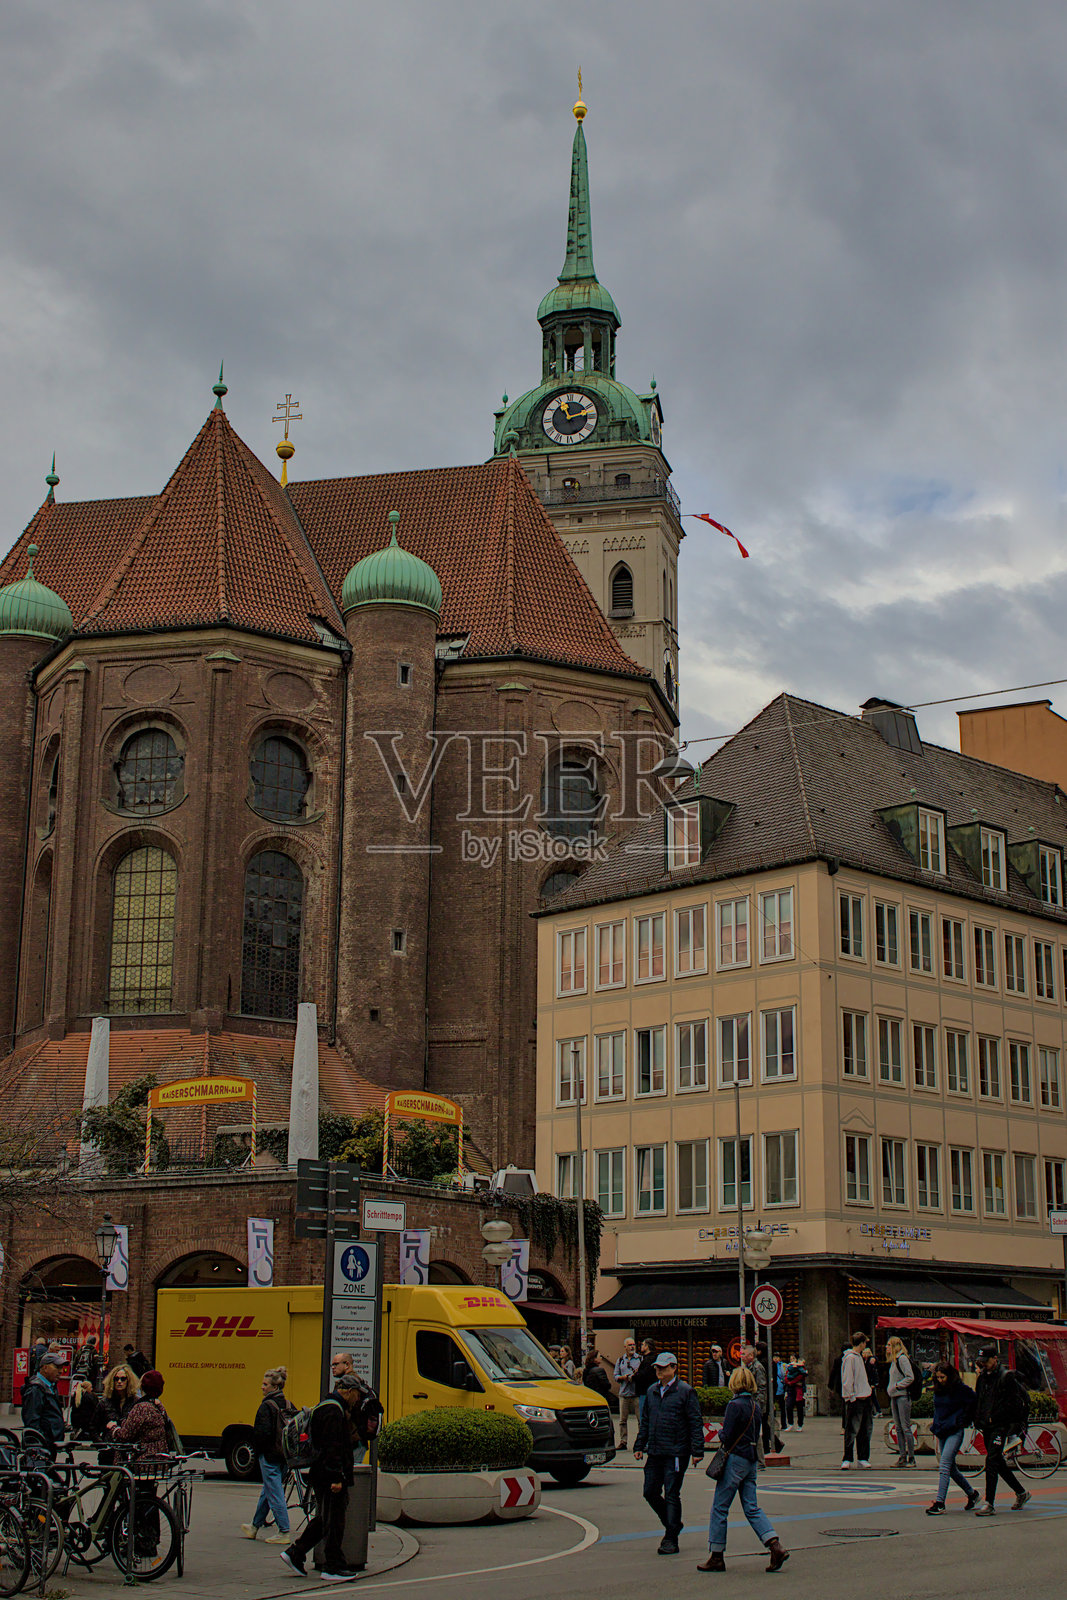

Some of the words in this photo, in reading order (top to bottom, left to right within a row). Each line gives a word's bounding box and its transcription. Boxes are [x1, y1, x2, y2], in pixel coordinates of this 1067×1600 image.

[343, 1283, 366, 1294] ZONE
[463, 1296, 508, 1308] DHL
[183, 1315, 259, 1337] DHL
[629, 1318, 659, 1328] PREMIUM
[660, 1318, 682, 1327] DUTCH
[683, 1317, 708, 1327] CHEESE
